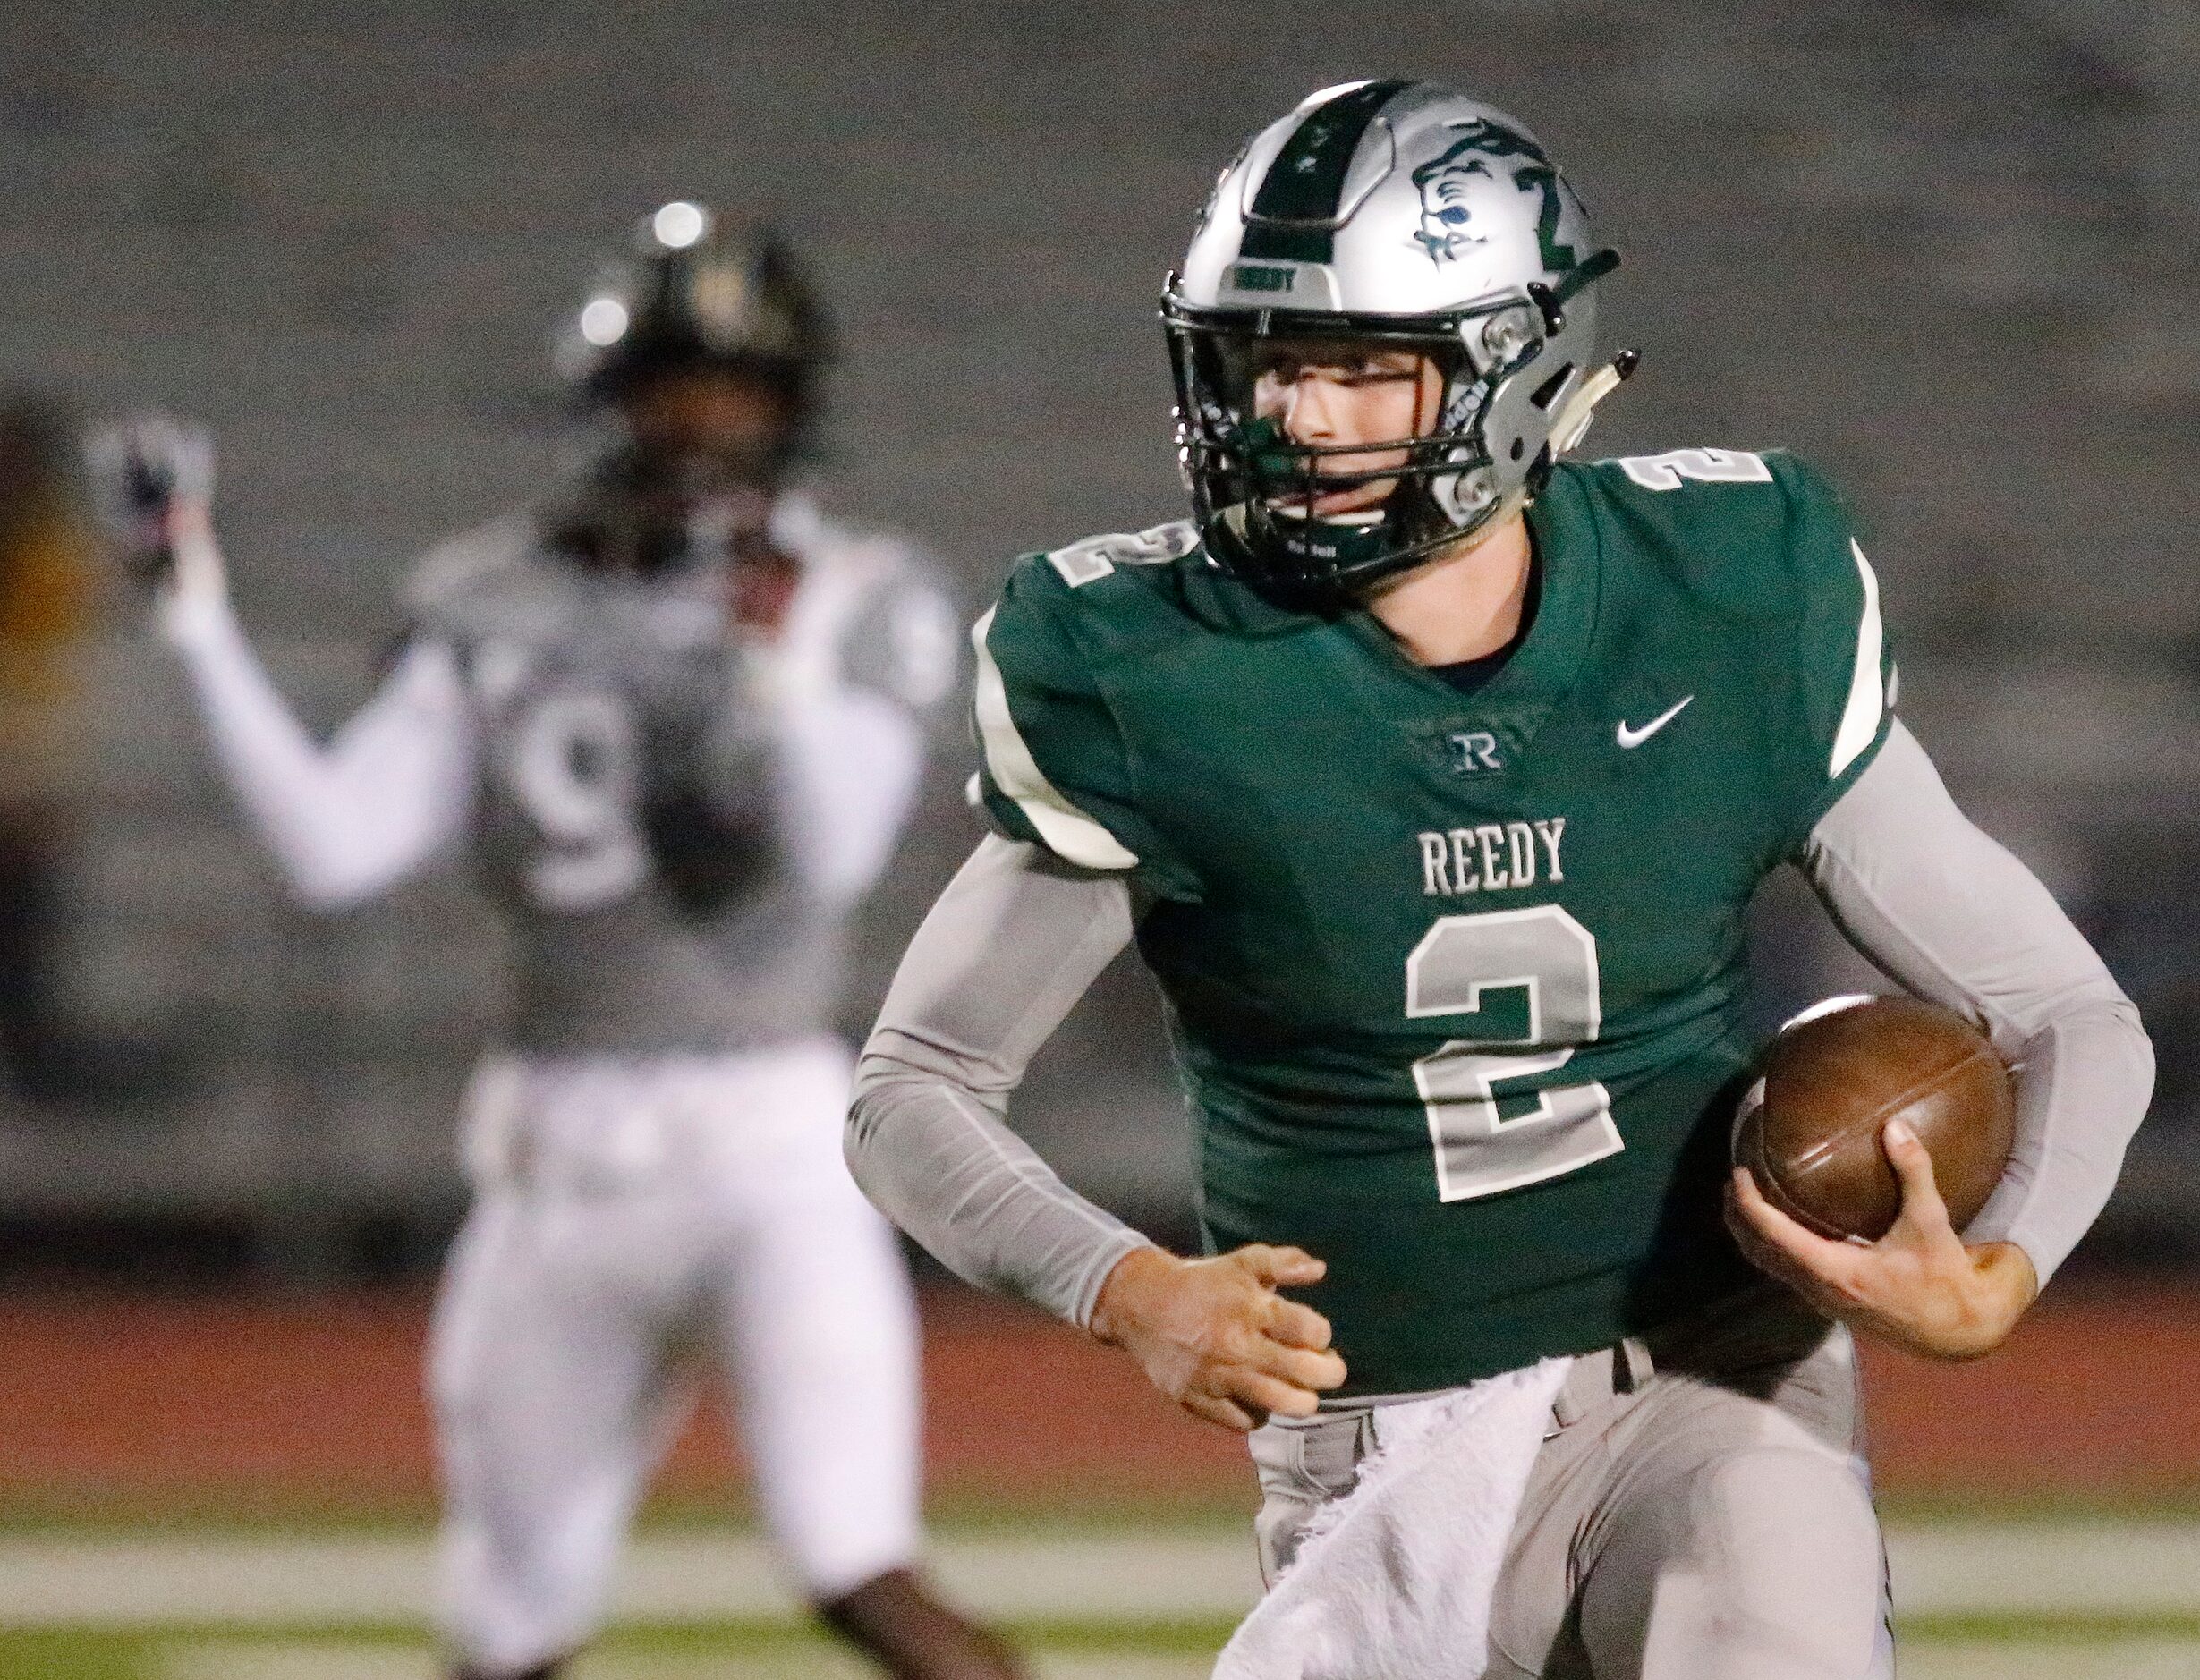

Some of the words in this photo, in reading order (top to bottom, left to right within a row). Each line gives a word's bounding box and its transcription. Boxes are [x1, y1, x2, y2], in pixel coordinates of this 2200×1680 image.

[1618, 447, 1774, 491] 2
[1047, 519, 1201, 588] 2
[1448, 732, 1503, 772] R
[1418, 818, 1567, 895] REEDY
[1406, 904, 1626, 1203] 2
